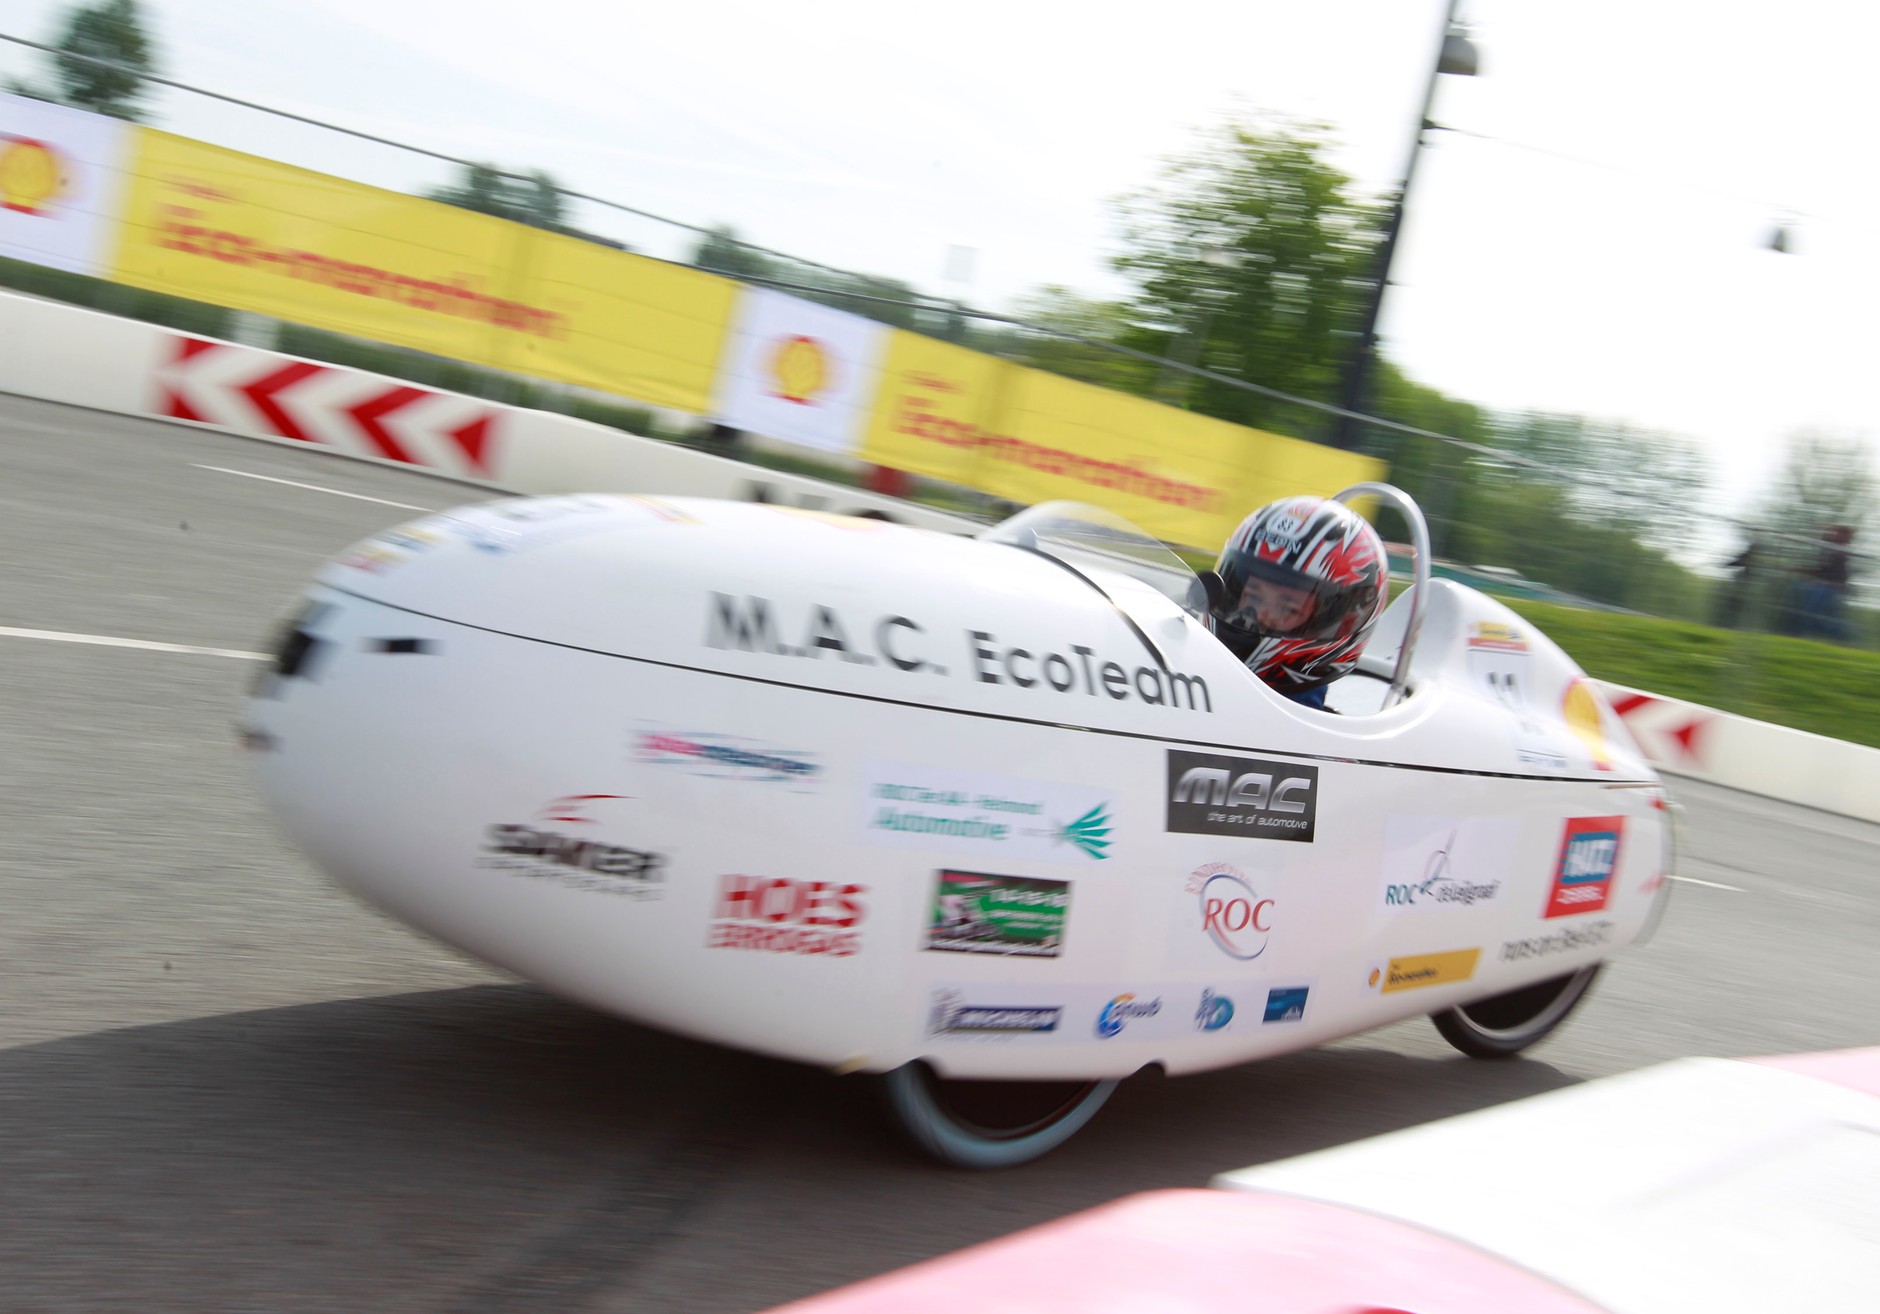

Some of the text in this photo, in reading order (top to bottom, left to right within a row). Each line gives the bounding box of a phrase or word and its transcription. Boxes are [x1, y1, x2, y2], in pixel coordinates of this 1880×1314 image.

[704, 590, 1214, 714] M.A.C. EcoTeam
[1172, 767, 1312, 814] MAC
[1207, 810, 1308, 830] the art of automotive
[711, 873, 872, 928] HOES
[1384, 883, 1419, 905] ROC
[1202, 897, 1275, 940] ROC
